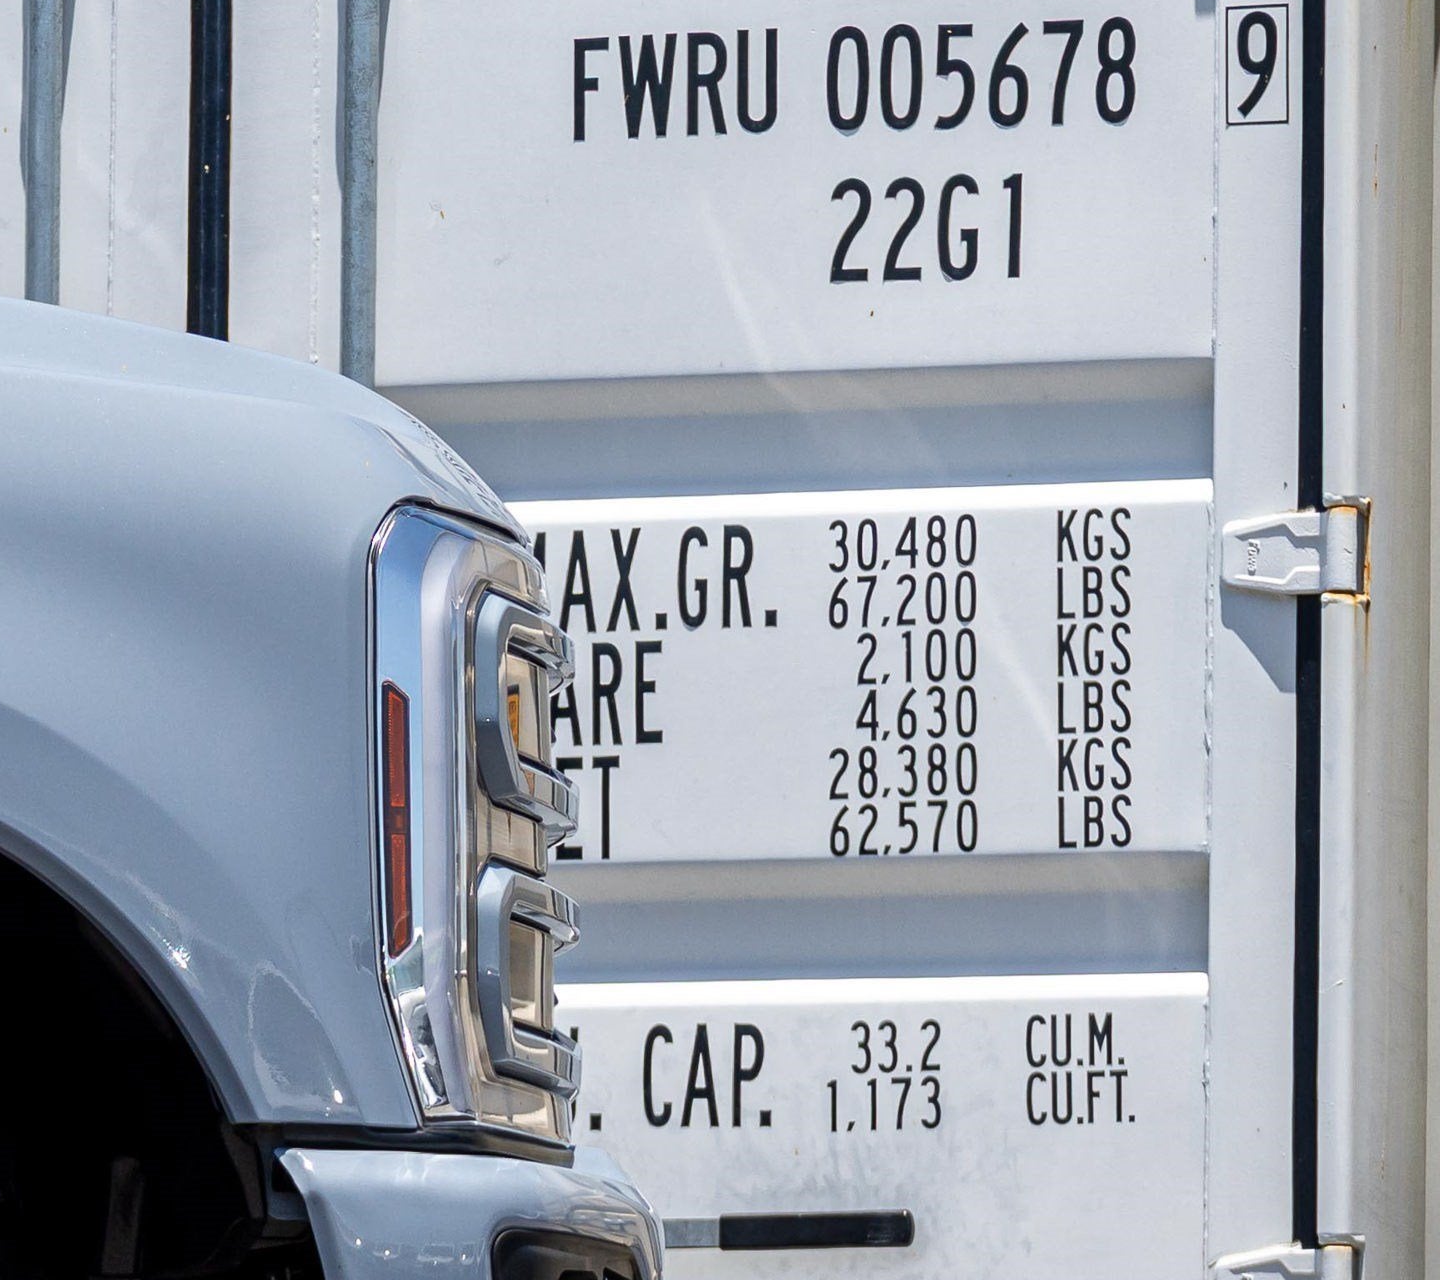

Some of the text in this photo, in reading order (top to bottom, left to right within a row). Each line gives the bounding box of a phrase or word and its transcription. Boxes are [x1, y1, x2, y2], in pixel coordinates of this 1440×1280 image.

[571, 10, 1278, 142] FWRU 005678 9
[830, 172, 1024, 283] 22G1
[828, 514, 977, 573] 30,480
[1056, 507, 1132, 562] KGS
[828, 565, 1132, 630] 67,200 LBS
[552, 640, 664, 745] ARE
[856, 627, 978, 686] 2,100
[1056, 622, 1132, 677] KGS
[855, 679, 1132, 742] 4,630 LBS
[828, 743, 978, 801] 28,380
[1056, 736, 1132, 792] KGS
[828, 793, 1132, 857] 62,570 LBS
[642, 1023, 773, 1128] CAP.
[850, 1018, 942, 1074] 33.2
[1025, 1011, 1126, 1068] CU.M.
[826, 1068, 1137, 1133] 1,173 CU.FT.
